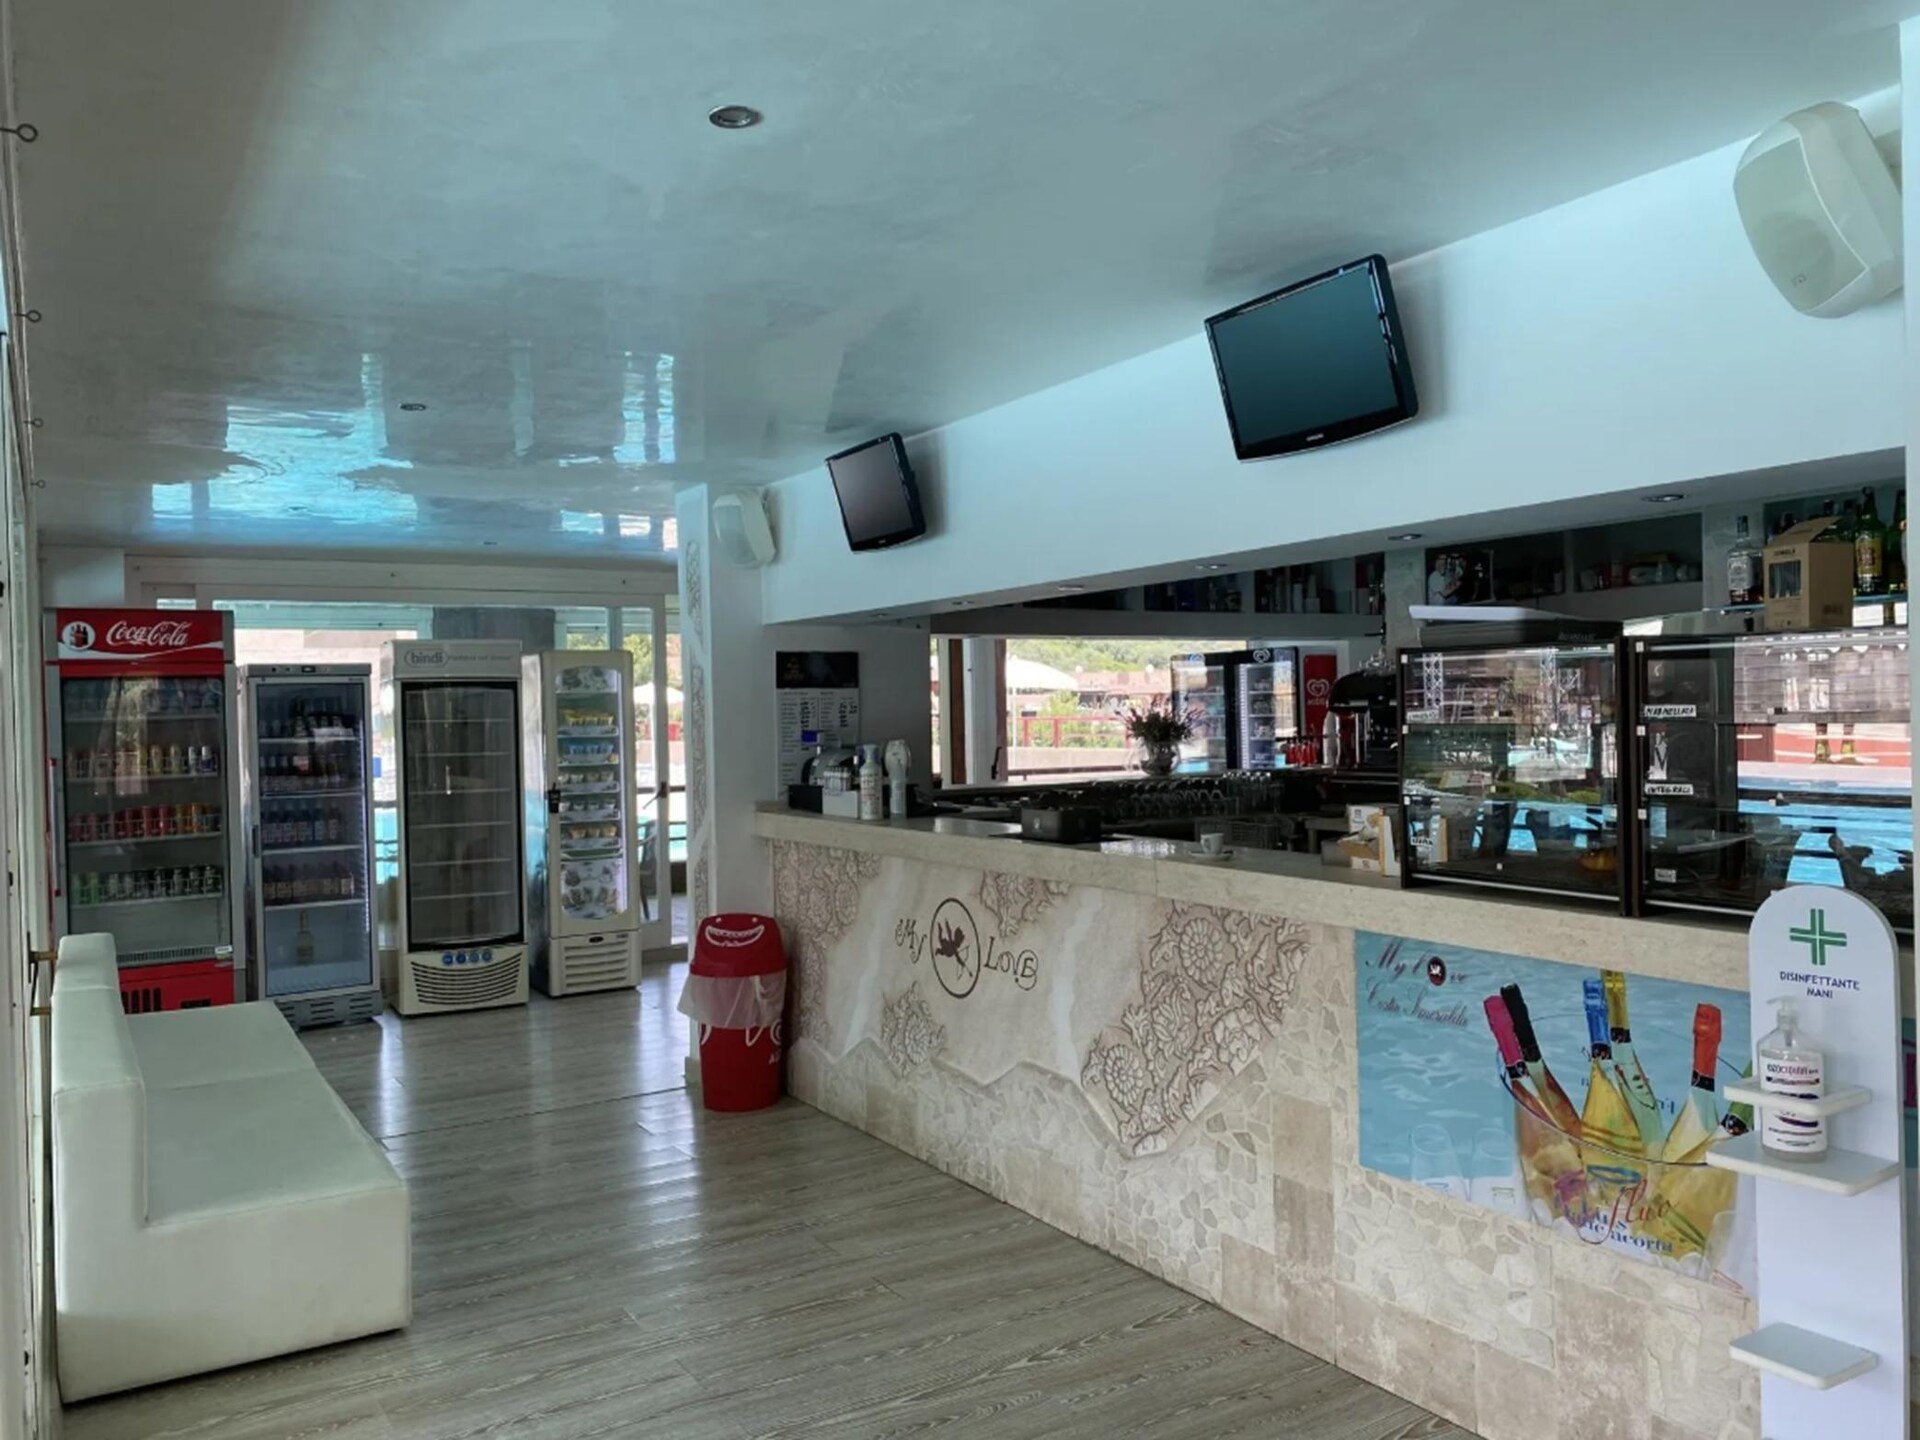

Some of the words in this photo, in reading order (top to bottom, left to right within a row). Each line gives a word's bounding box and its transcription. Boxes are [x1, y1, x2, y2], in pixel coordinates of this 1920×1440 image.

[106, 620, 193, 646] Coca-Cola
[411, 652, 444, 665] bindi
[1779, 971, 1861, 991] DISINFETTANTE
[1806, 987, 1833, 999] MANI
